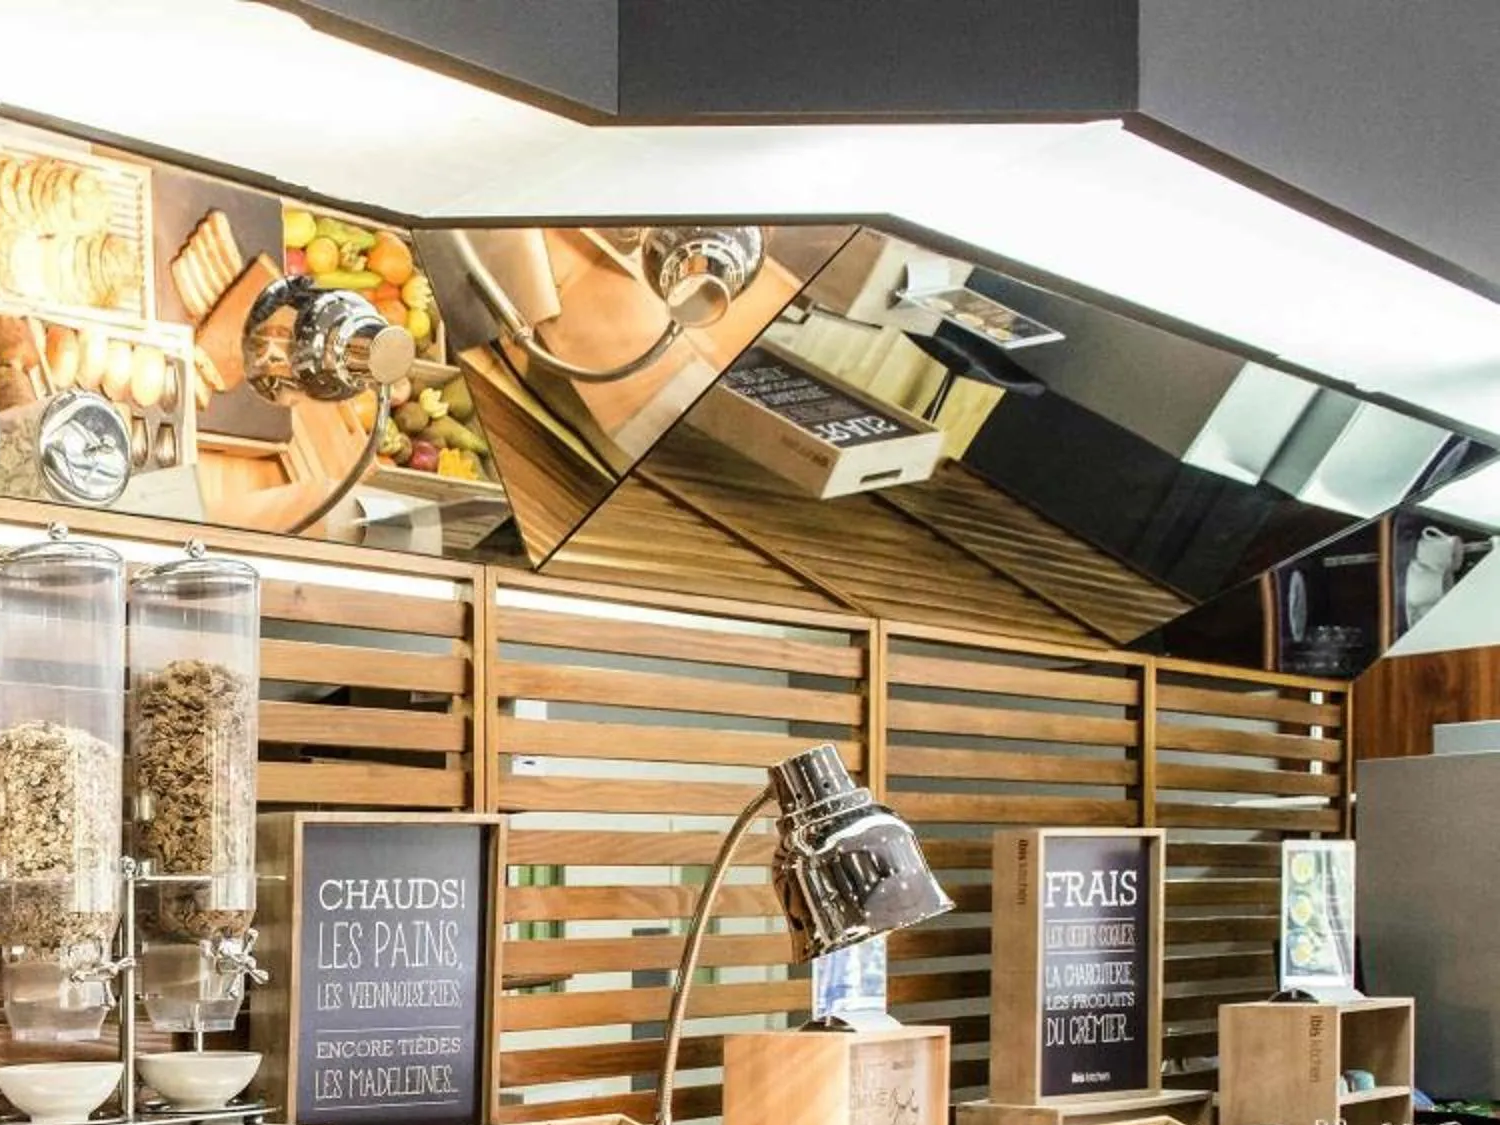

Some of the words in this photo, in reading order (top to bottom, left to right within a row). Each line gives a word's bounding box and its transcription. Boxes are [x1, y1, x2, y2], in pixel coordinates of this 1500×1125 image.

[319, 878, 466, 911] CHAUDS!
[1045, 870, 1137, 907] FRAIS
[318, 921, 363, 970] LES
[374, 920, 463, 970] PAINS,
[317, 983, 343, 1011] LES
[1071, 991, 1136, 1010] PRODUITS
[316, 1039, 394, 1060] ENCORE
[398, 1034, 462, 1056] TIÈDES
[1046, 1017, 1065, 1047] DU
[315, 1069, 343, 1100] LES
